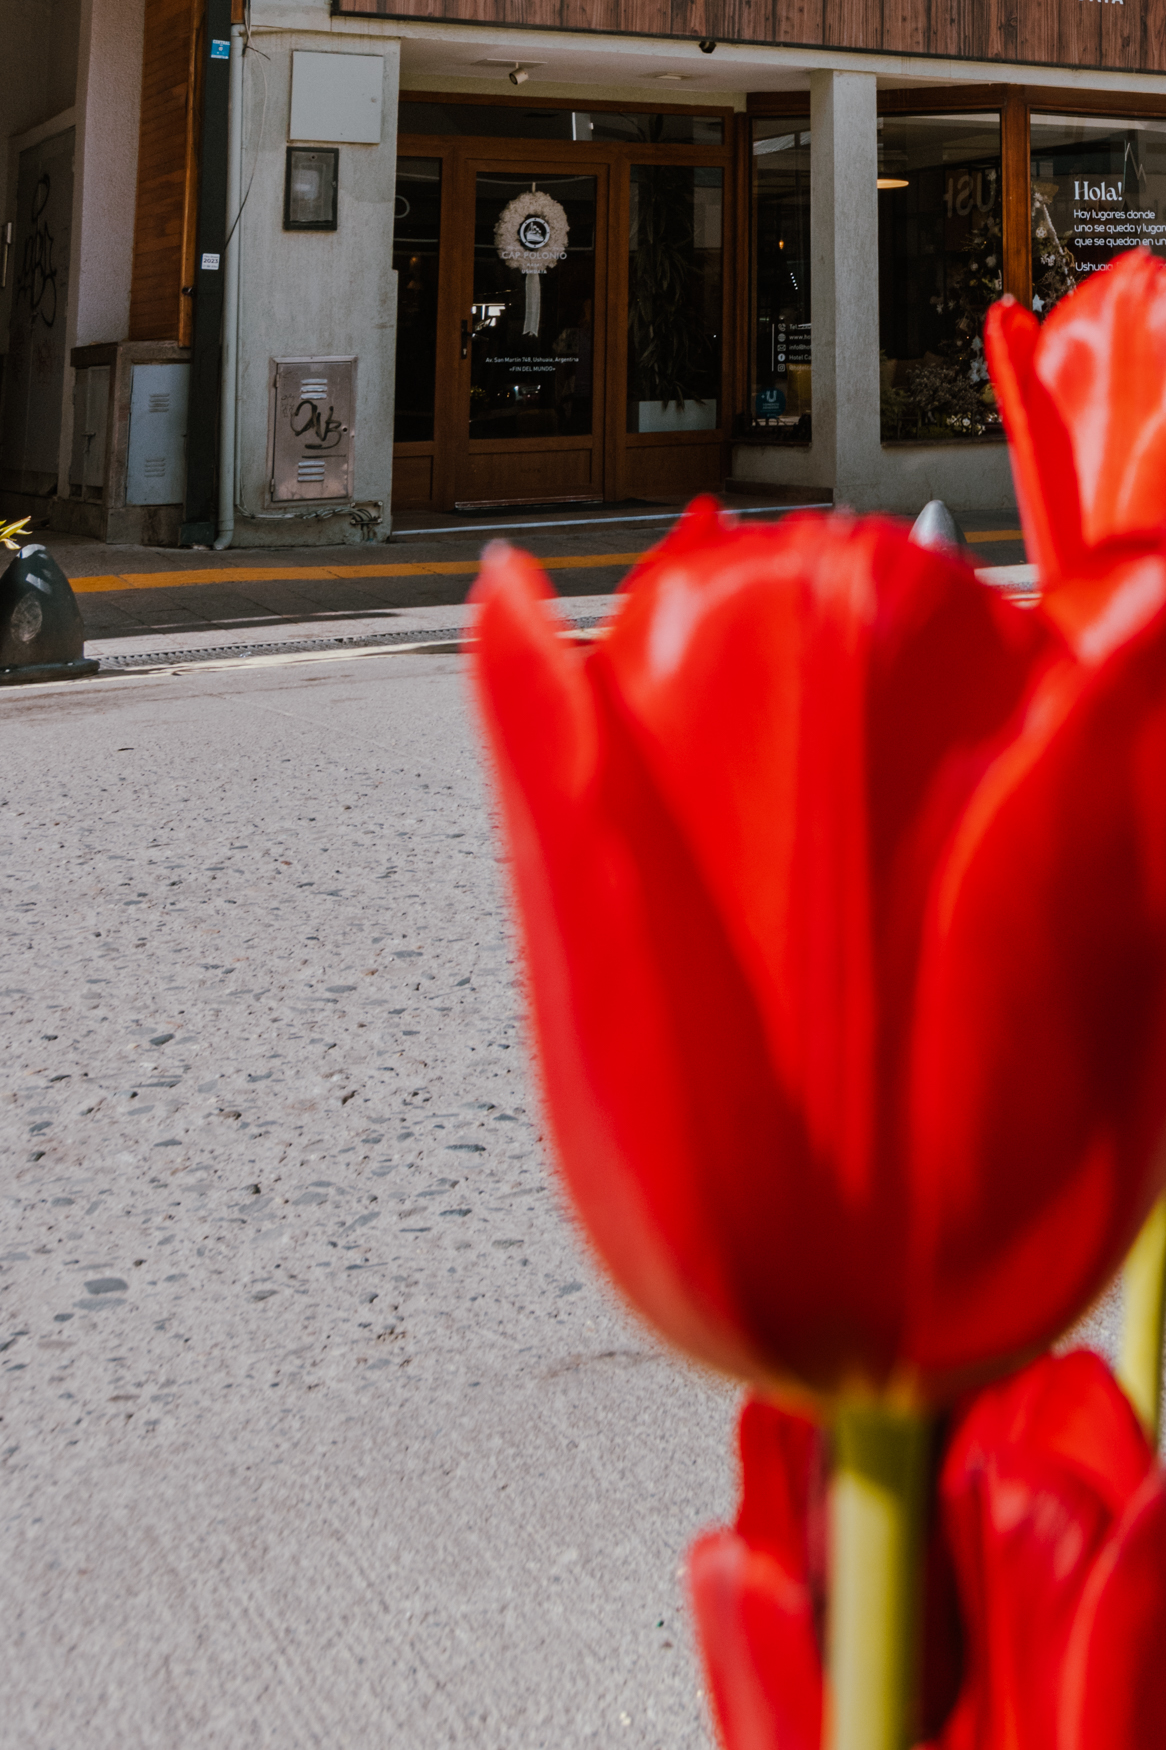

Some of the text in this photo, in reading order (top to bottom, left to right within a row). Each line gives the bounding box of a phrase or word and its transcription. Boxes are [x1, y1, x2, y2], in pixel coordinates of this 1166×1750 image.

[1074, 181, 1123, 201] Hola!
[1073, 209, 1091, 221] Hay
[1092, 210, 1125, 221] lugares
[1126, 210, 1156, 219] donde
[1074, 224, 1093, 232] uno
[1094, 224, 1105, 232] se
[1106, 223, 1135, 234] queda
[1136, 224, 1141, 234] y
[1074, 238, 1093, 248] que
[1094, 237, 1105, 246] se
[1106, 236, 1140, 248] quedan
[1142, 238, 1154, 246] en
[501, 251, 567, 260] CAP POLONIO
